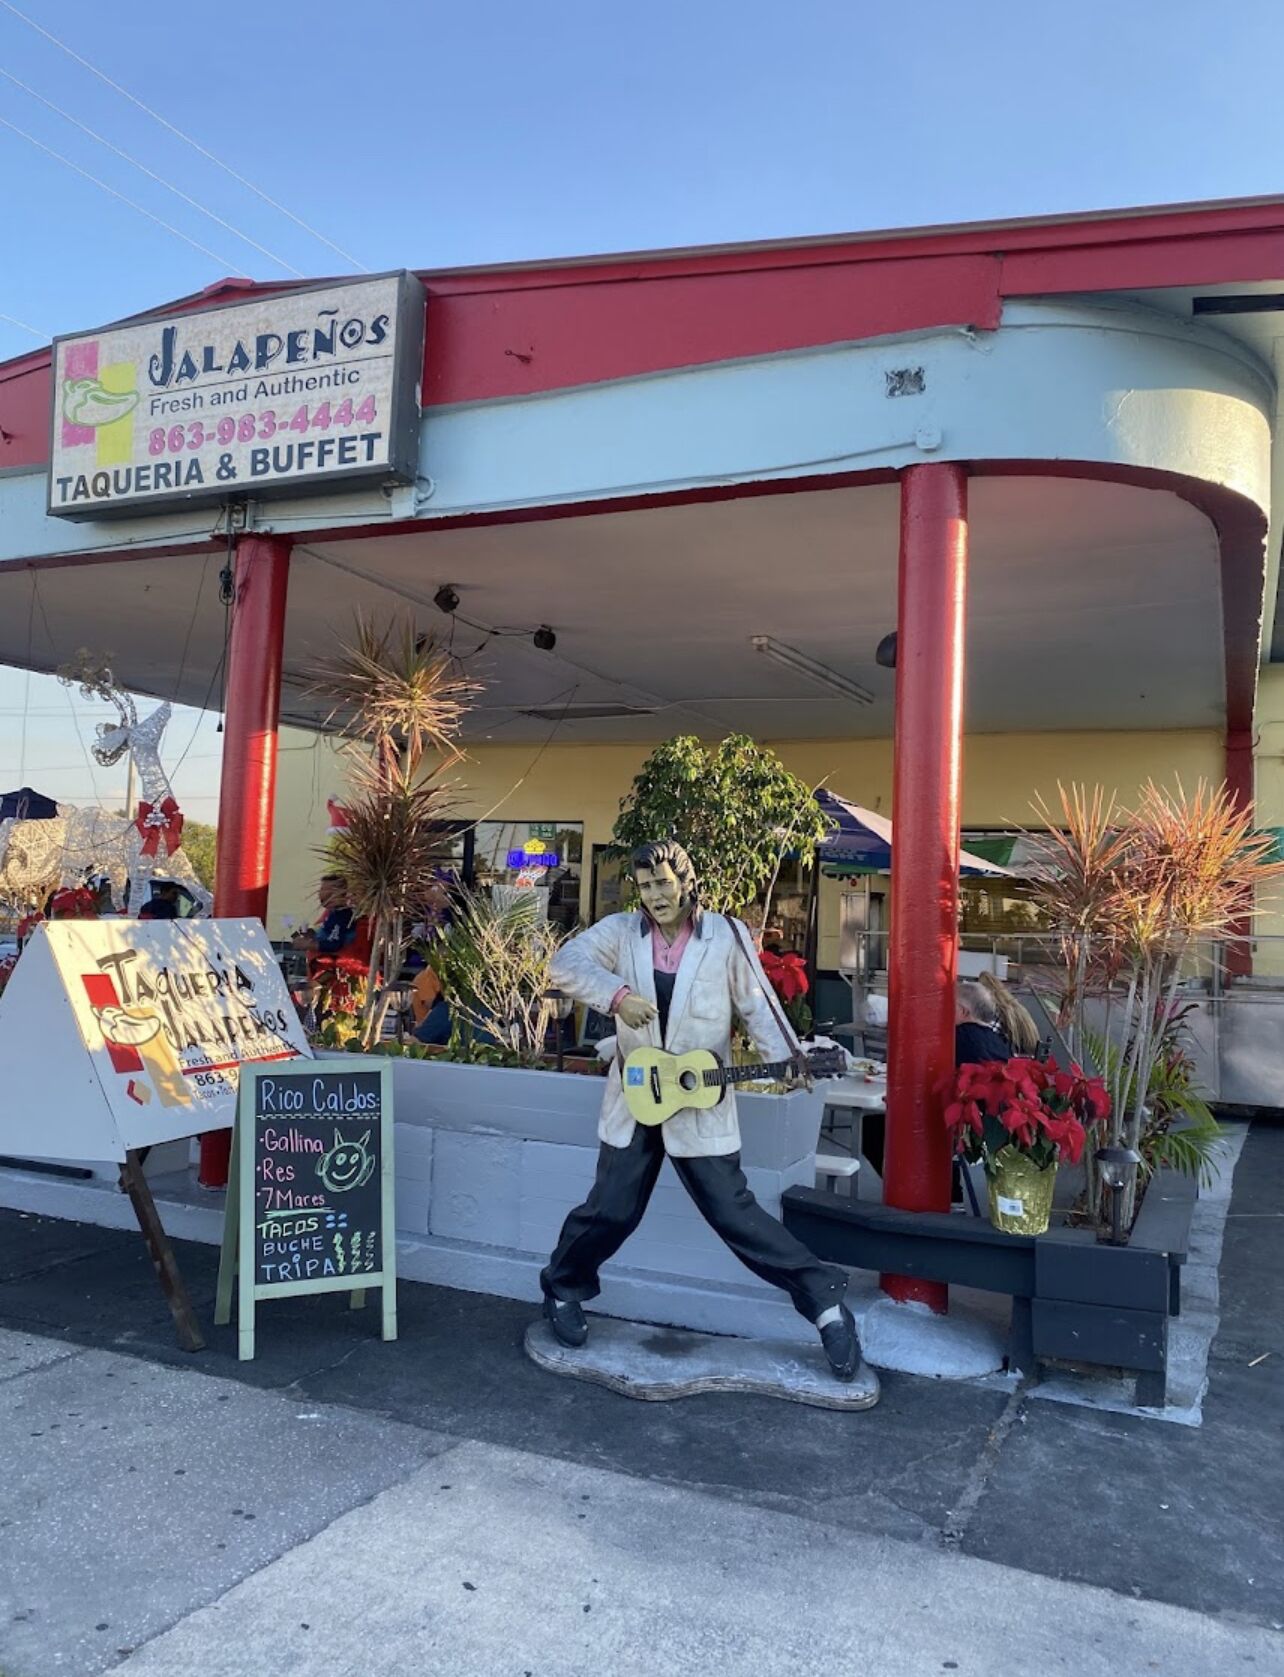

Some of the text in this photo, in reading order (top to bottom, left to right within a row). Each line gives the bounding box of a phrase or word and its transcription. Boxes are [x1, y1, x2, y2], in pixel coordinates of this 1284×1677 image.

[148, 308, 390, 388] JALAPEÑOS
[150, 367, 361, 416] Fresh and Authentic
[148, 394, 378, 457] 863-983-4444
[57, 432, 382, 503] TAQUERIA & BUFFET
[178, 1054, 213, 1069] Fresh
[215, 1051, 238, 1063] and
[261, 1079, 304, 1111] Rico
[262, 1158, 296, 1181] Res
[256, 1217, 319, 1239] TACOS
[263, 1235, 324, 1257] BUCHE
